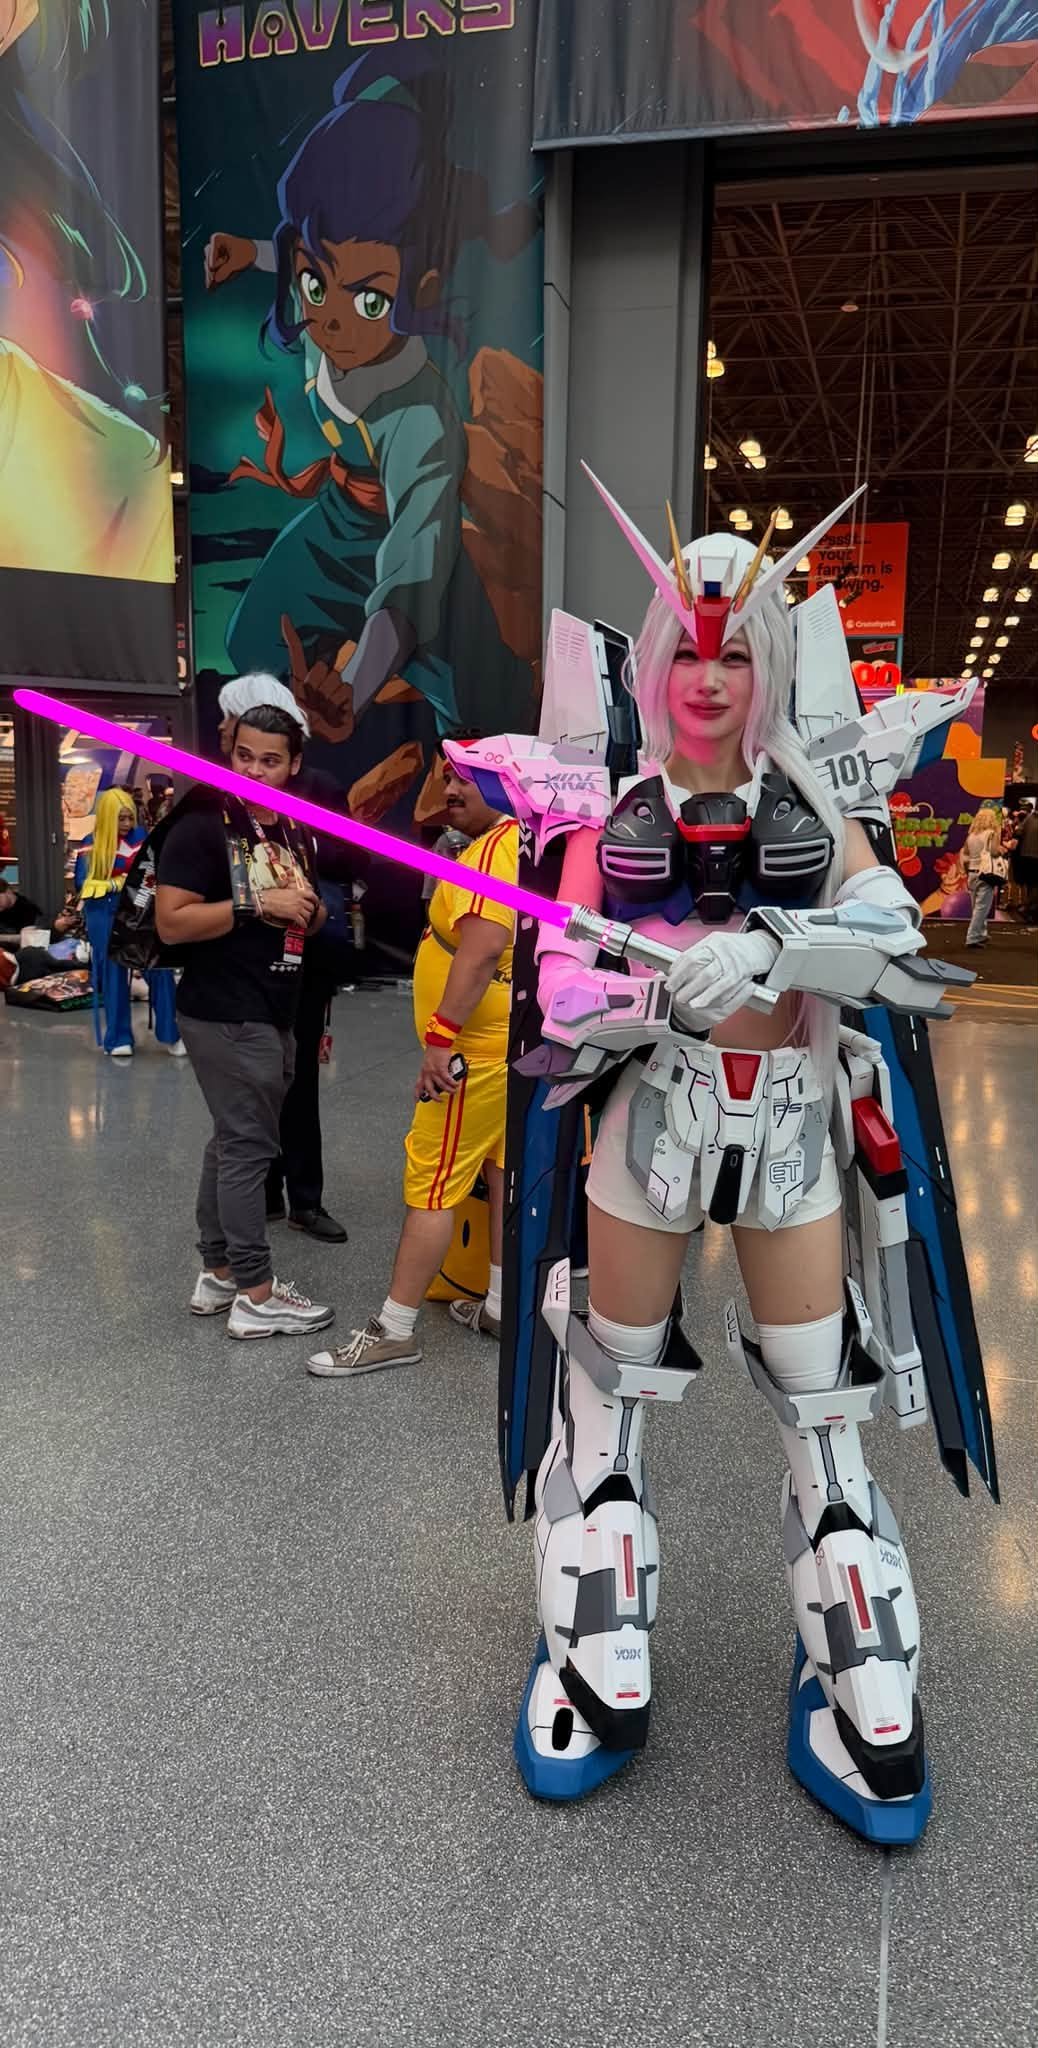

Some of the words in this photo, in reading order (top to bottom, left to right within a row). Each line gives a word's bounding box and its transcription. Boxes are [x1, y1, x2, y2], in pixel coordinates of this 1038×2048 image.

[816, 562, 876, 576] fanom
[881, 561, 893, 574] is
[816, 577, 885, 593] swing.
[825, 750, 873, 790] 101
[769, 1160, 801, 1184] ET
